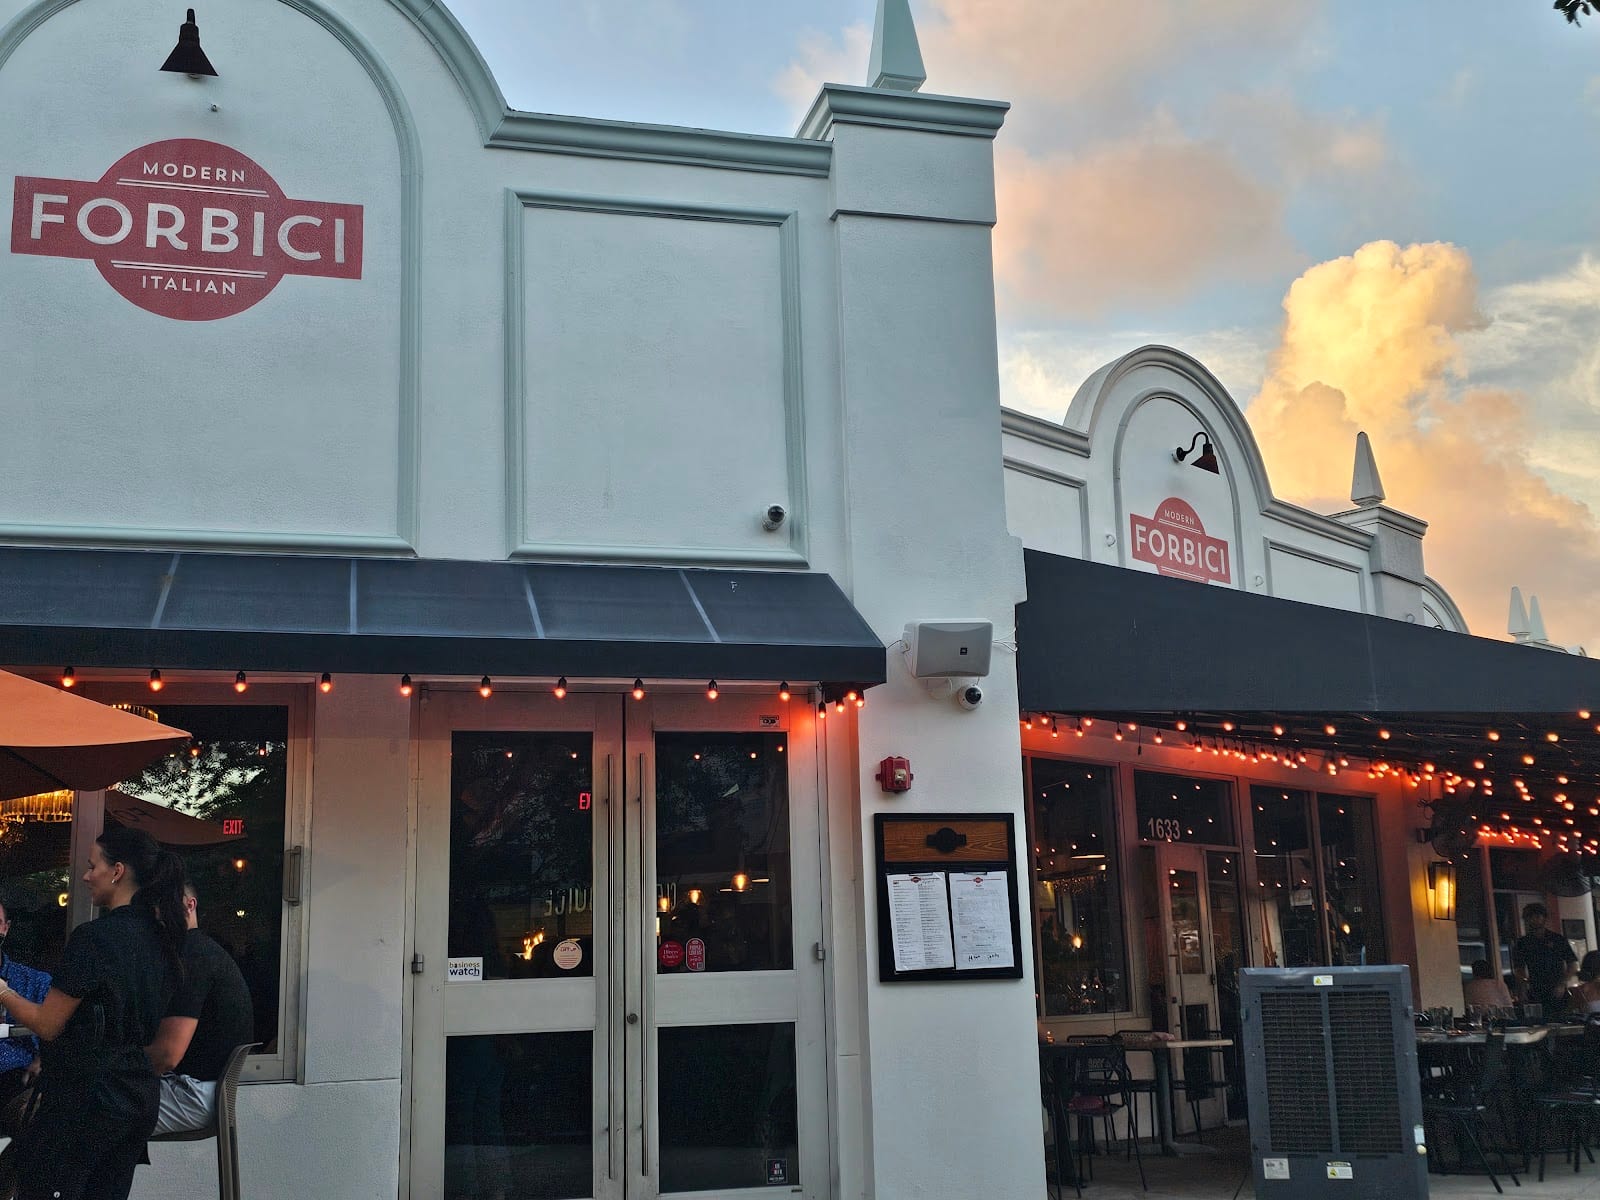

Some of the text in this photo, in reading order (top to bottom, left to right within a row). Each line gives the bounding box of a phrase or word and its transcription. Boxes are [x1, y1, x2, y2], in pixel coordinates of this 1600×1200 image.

[142, 161, 246, 183] MODERN
[30, 192, 346, 264] FORBICI
[141, 275, 236, 296] ITALIAN
[1164, 509, 1195, 525] MODERN
[1135, 523, 1226, 576] FORBICI
[579, 792, 591, 811] EX
[223, 819, 242, 834] EXIT
[1148, 816, 1181, 840] 1633
[449, 967, 480, 976] watch
